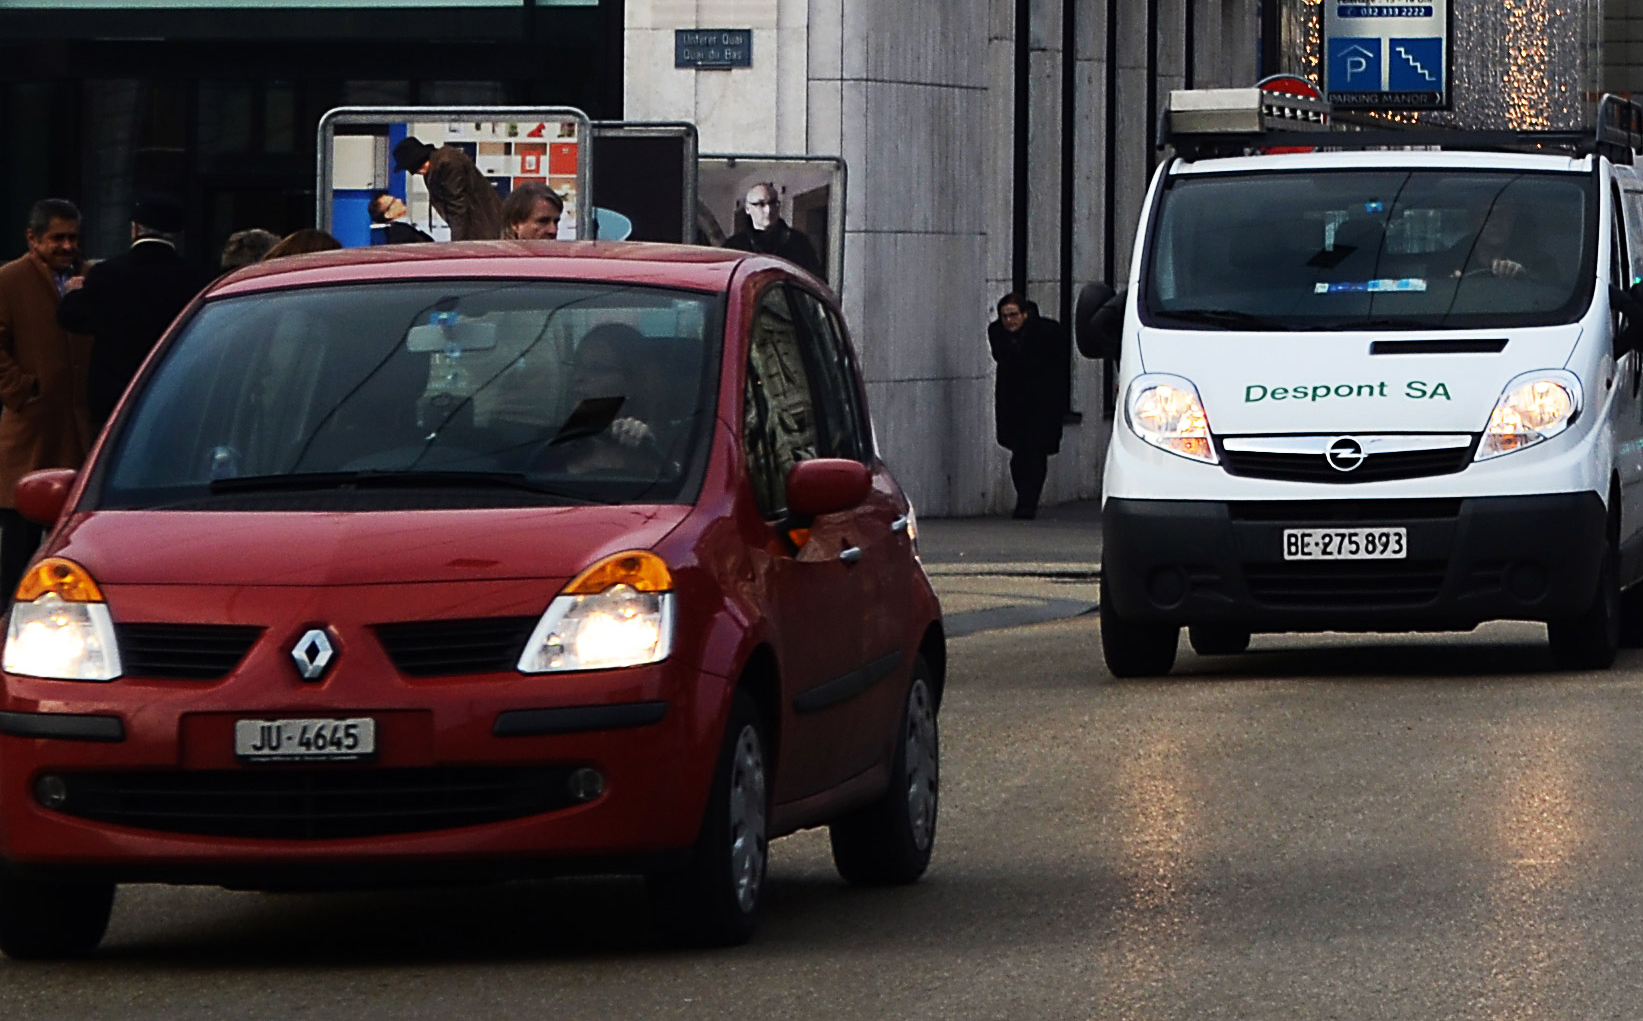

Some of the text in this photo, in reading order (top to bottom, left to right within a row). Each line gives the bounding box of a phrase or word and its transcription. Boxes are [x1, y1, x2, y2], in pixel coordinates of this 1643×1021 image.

[1330, 93, 1428, 104] PARKING MANOR
[1244, 380, 1452, 403] Despont SA
